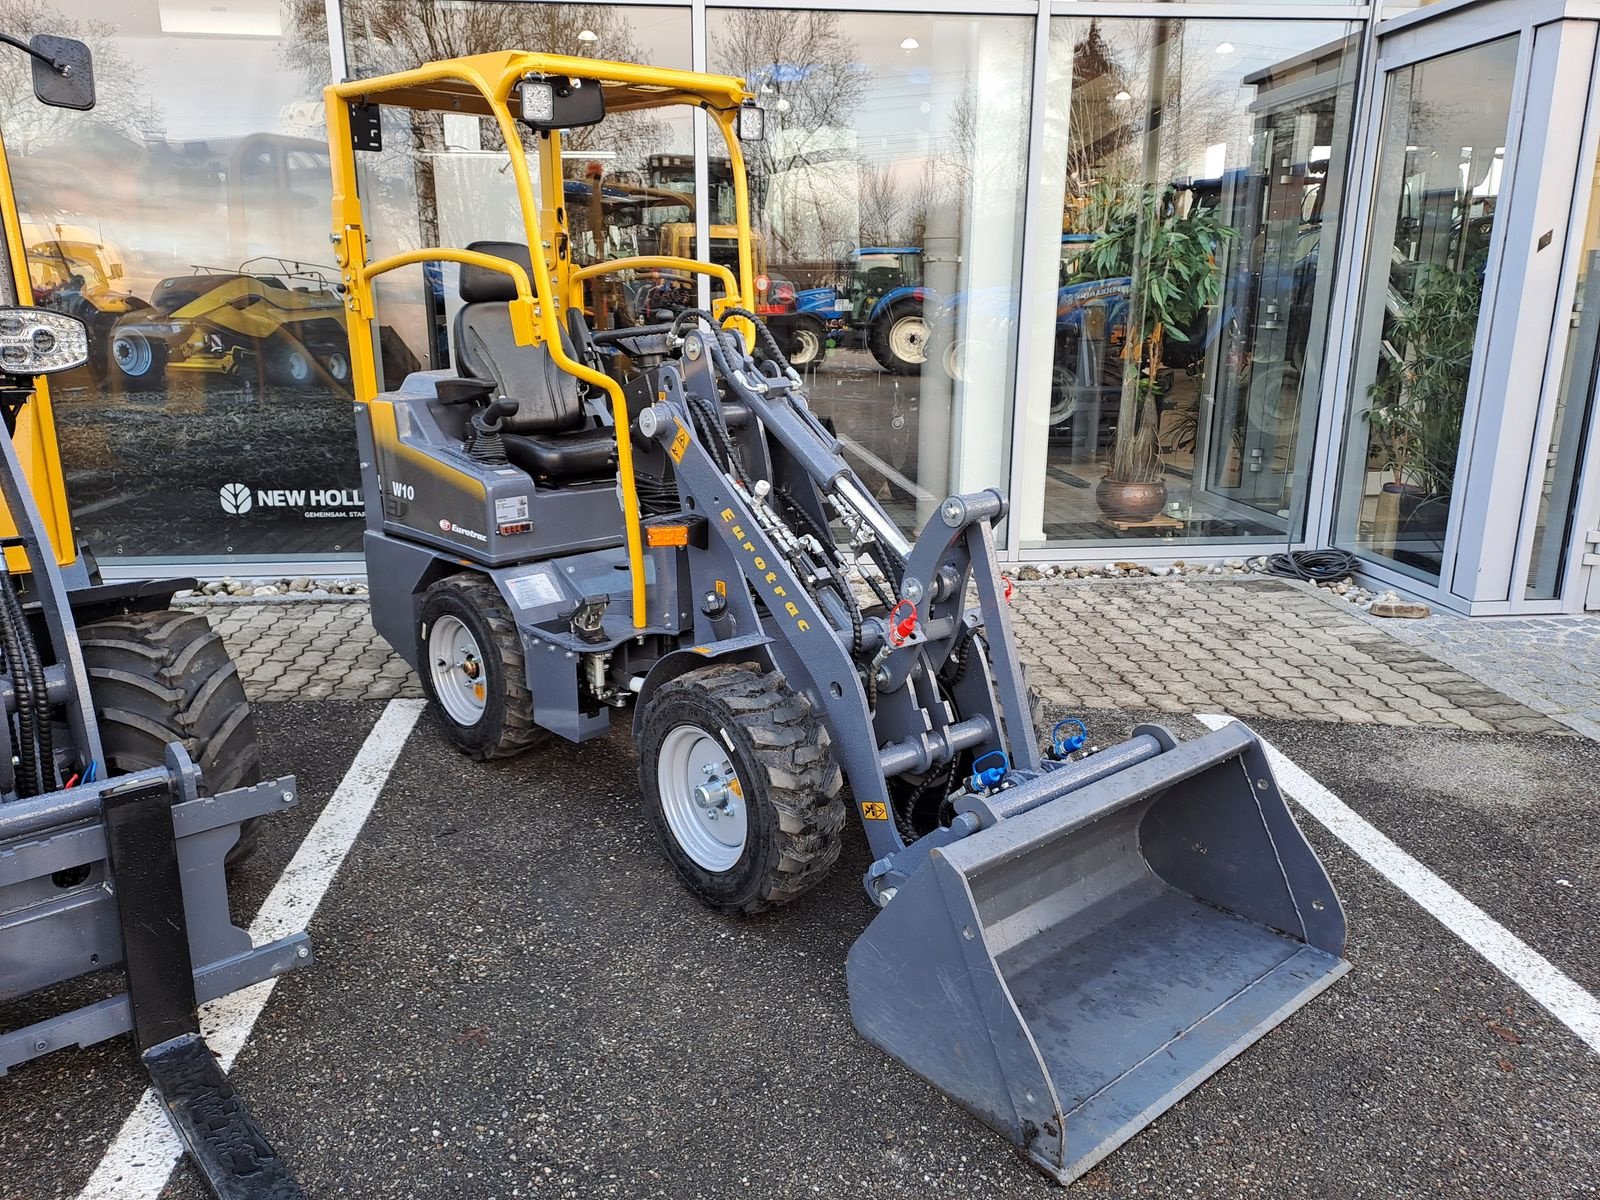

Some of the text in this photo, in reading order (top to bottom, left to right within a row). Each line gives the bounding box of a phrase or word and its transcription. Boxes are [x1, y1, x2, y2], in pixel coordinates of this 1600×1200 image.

[257, 489, 365, 507] NEW HOLL
[391, 480, 415, 501] W10
[451, 523, 488, 542] Eurotrac
[720, 507, 810, 632] Eurotrac
